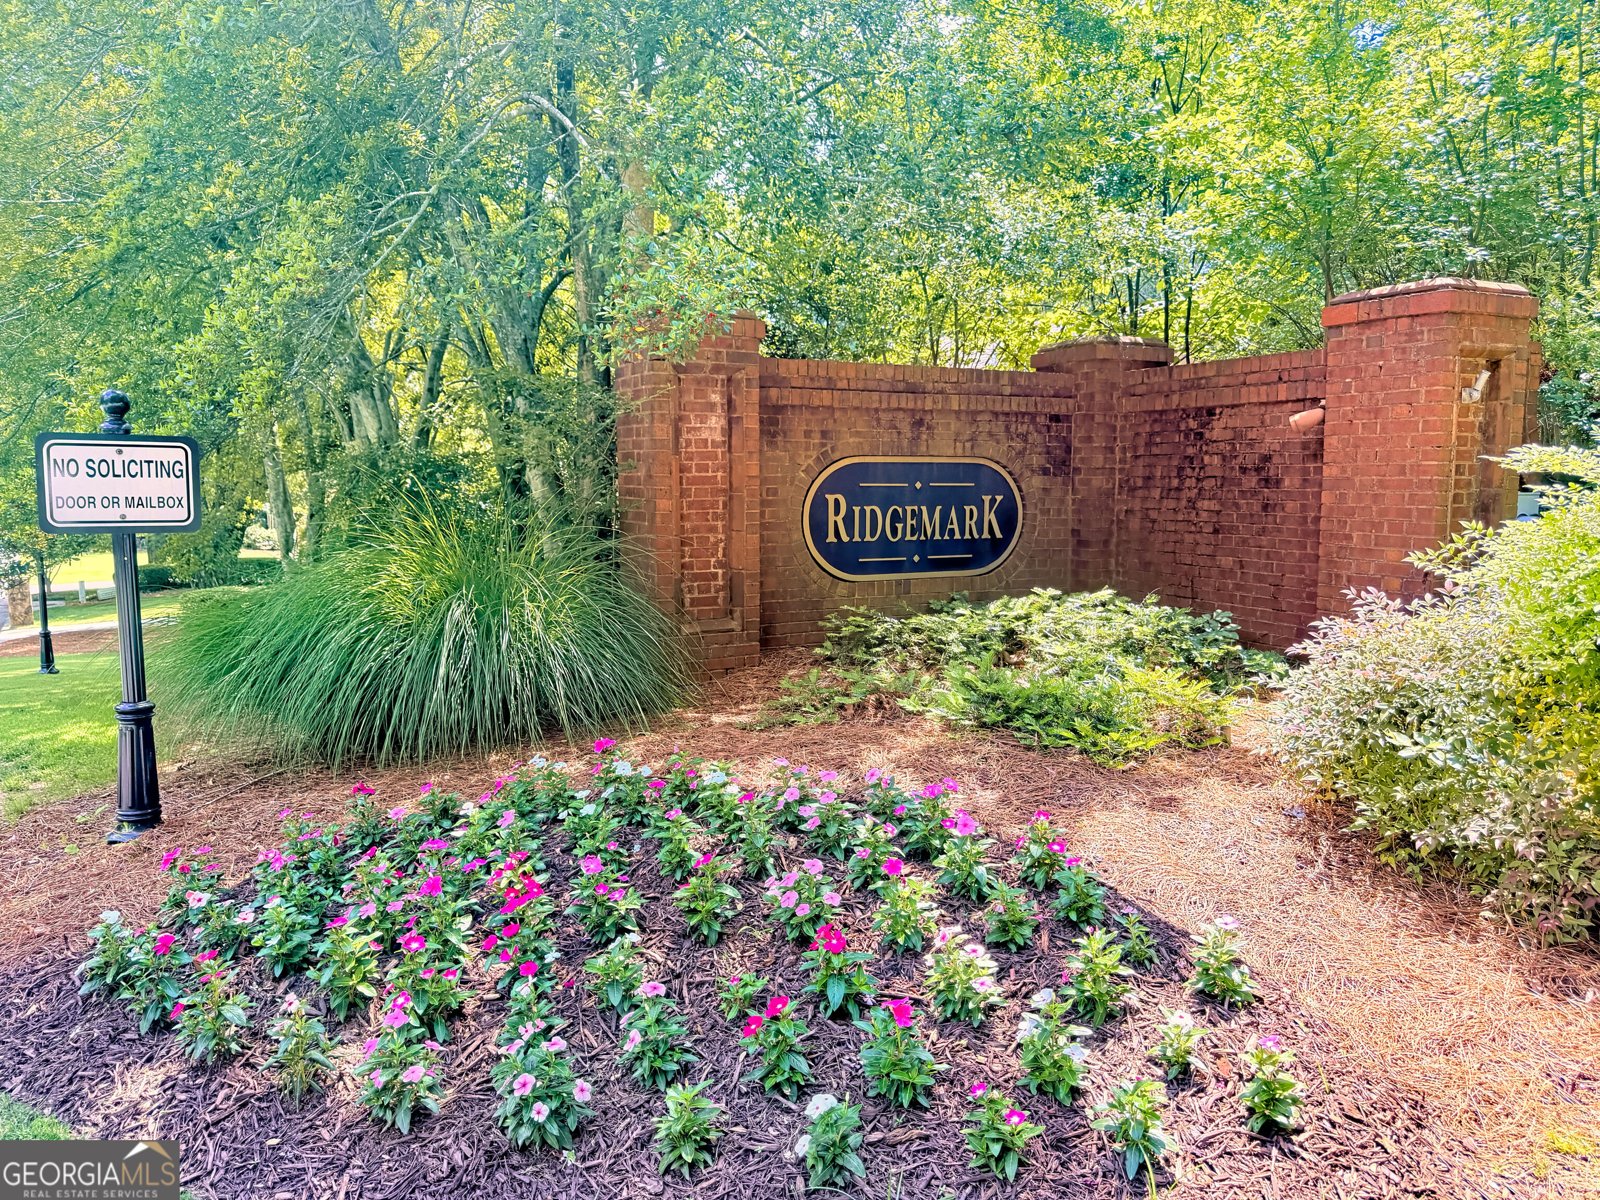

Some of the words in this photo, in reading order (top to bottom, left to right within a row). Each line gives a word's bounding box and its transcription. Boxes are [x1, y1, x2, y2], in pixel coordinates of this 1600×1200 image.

[53, 458, 79, 478] NO
[85, 458, 184, 479] SOLICITING
[55, 496, 97, 509] DOOR
[100, 496, 120, 509] OR
[125, 496, 184, 509] MAILBOX
[824, 493, 1004, 543] RIDGEMARK
